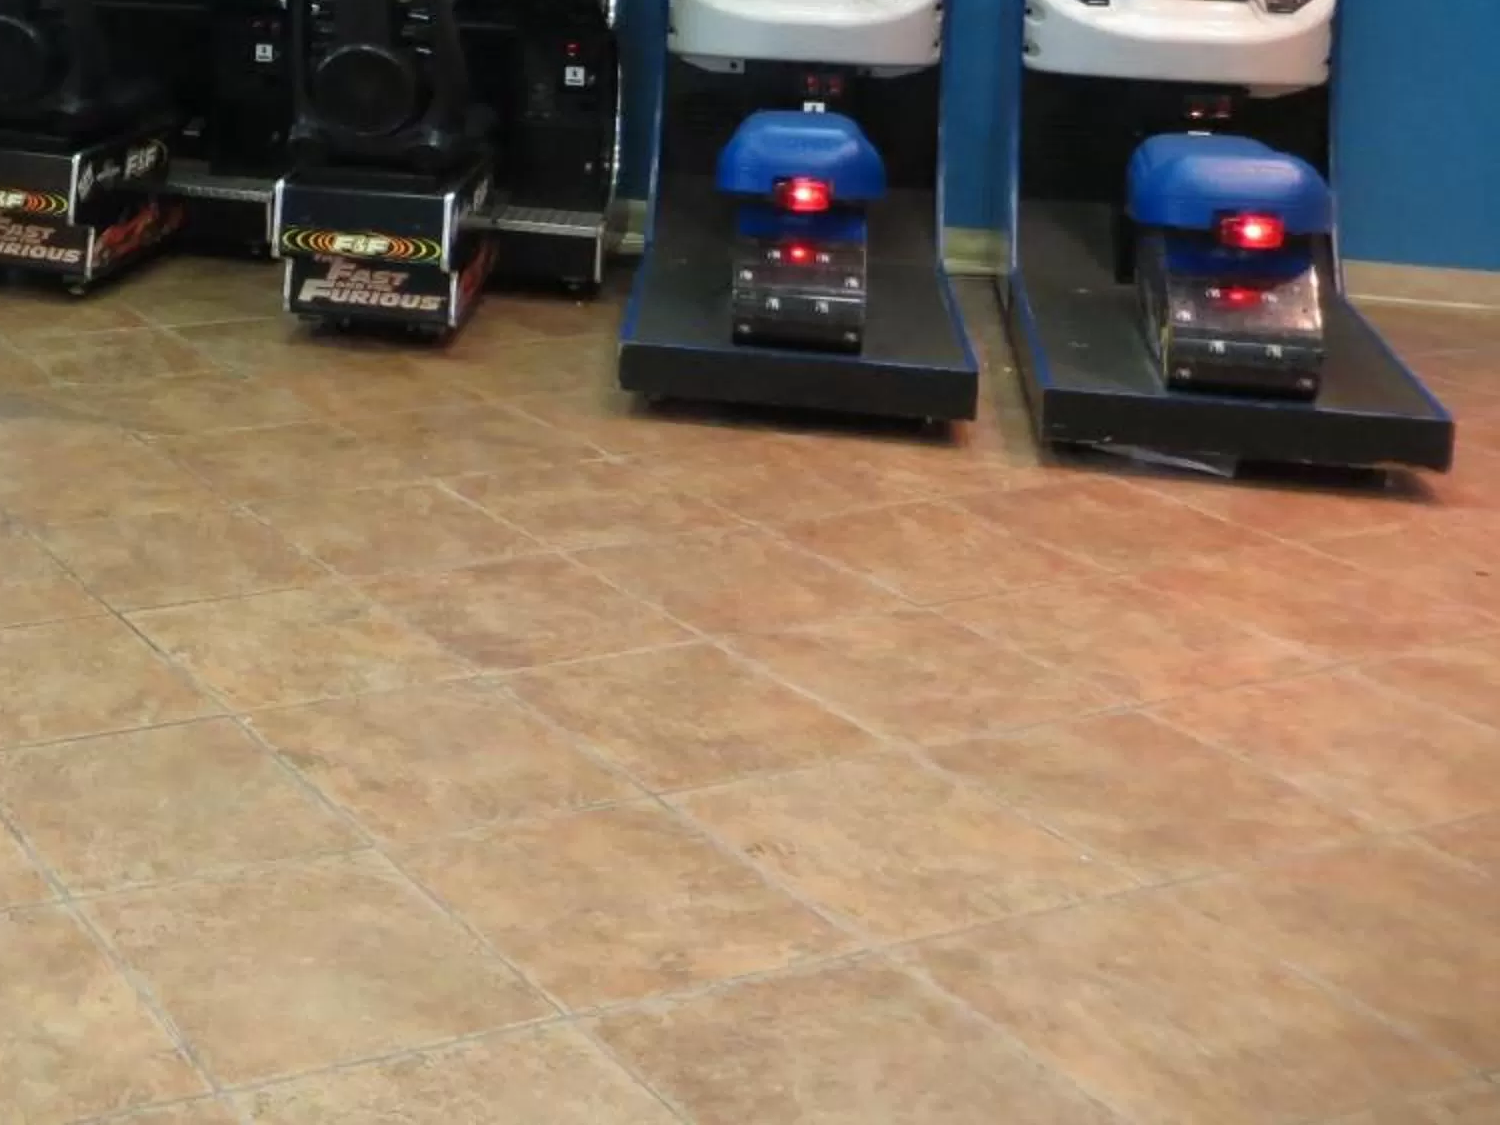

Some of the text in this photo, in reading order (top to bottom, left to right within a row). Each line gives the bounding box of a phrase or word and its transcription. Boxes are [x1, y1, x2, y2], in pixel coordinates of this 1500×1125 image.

[333, 234, 390, 254] F&F
[326, 257, 410, 287] FAST
[298, 278, 446, 311] FURIOUS
